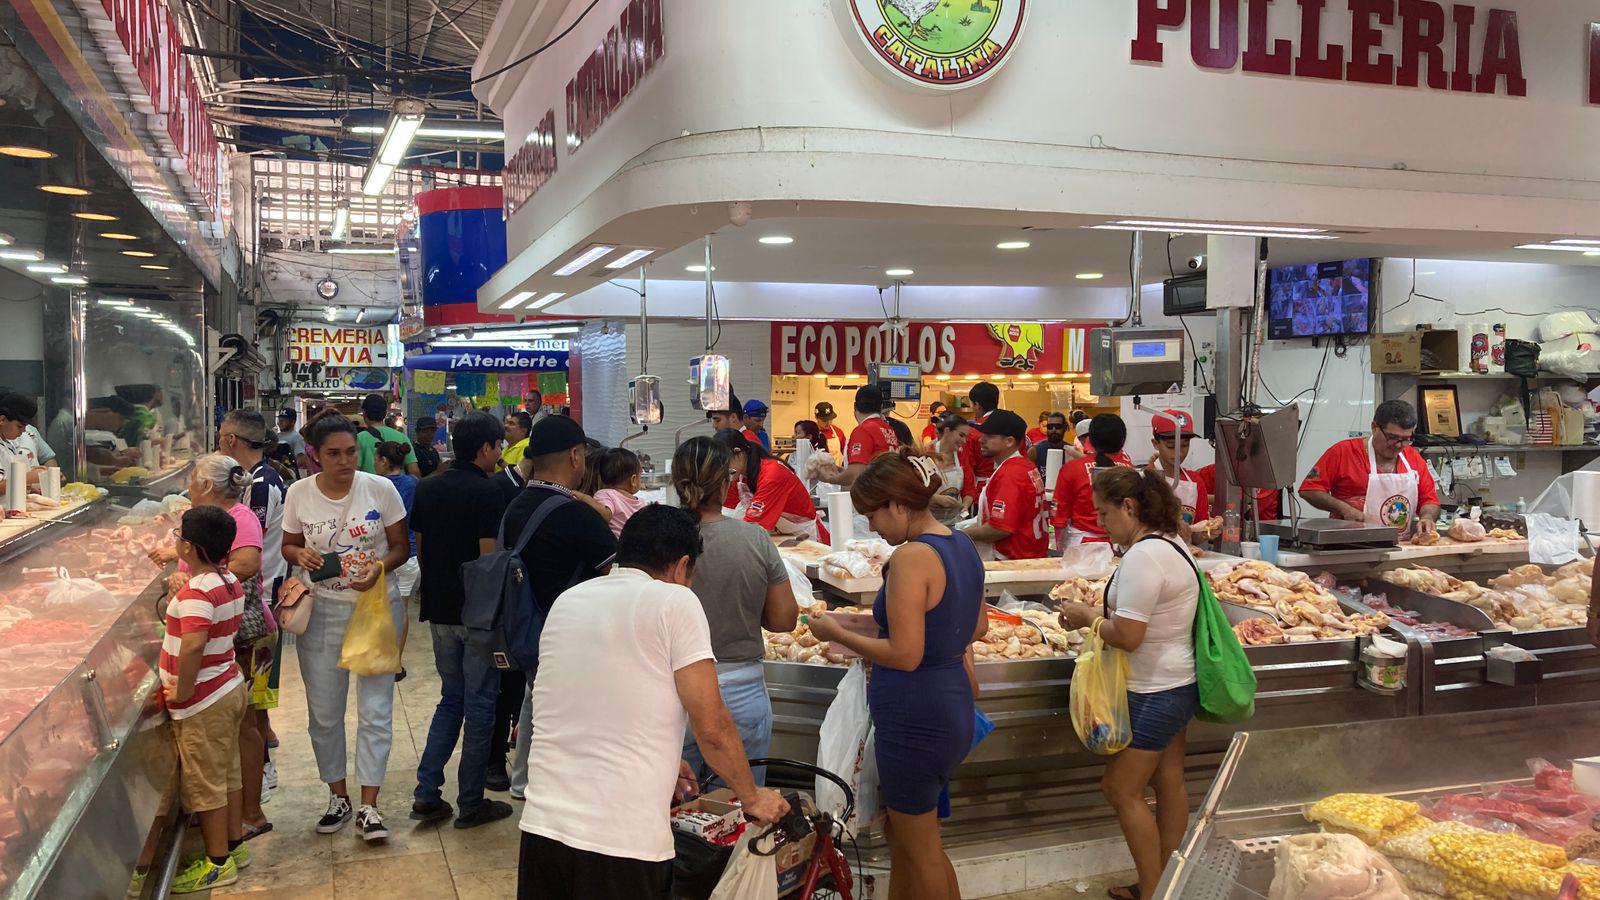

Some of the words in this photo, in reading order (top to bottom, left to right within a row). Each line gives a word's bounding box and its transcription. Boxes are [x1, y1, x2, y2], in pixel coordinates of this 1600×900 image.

[873, 24, 1003, 80] CATALINA
[286, 328, 386, 344] CREMERIA
[287, 346, 373, 363] OLIVIA
[781, 325, 838, 374] ECO
[450, 353, 557, 368] ¡Atenderte
